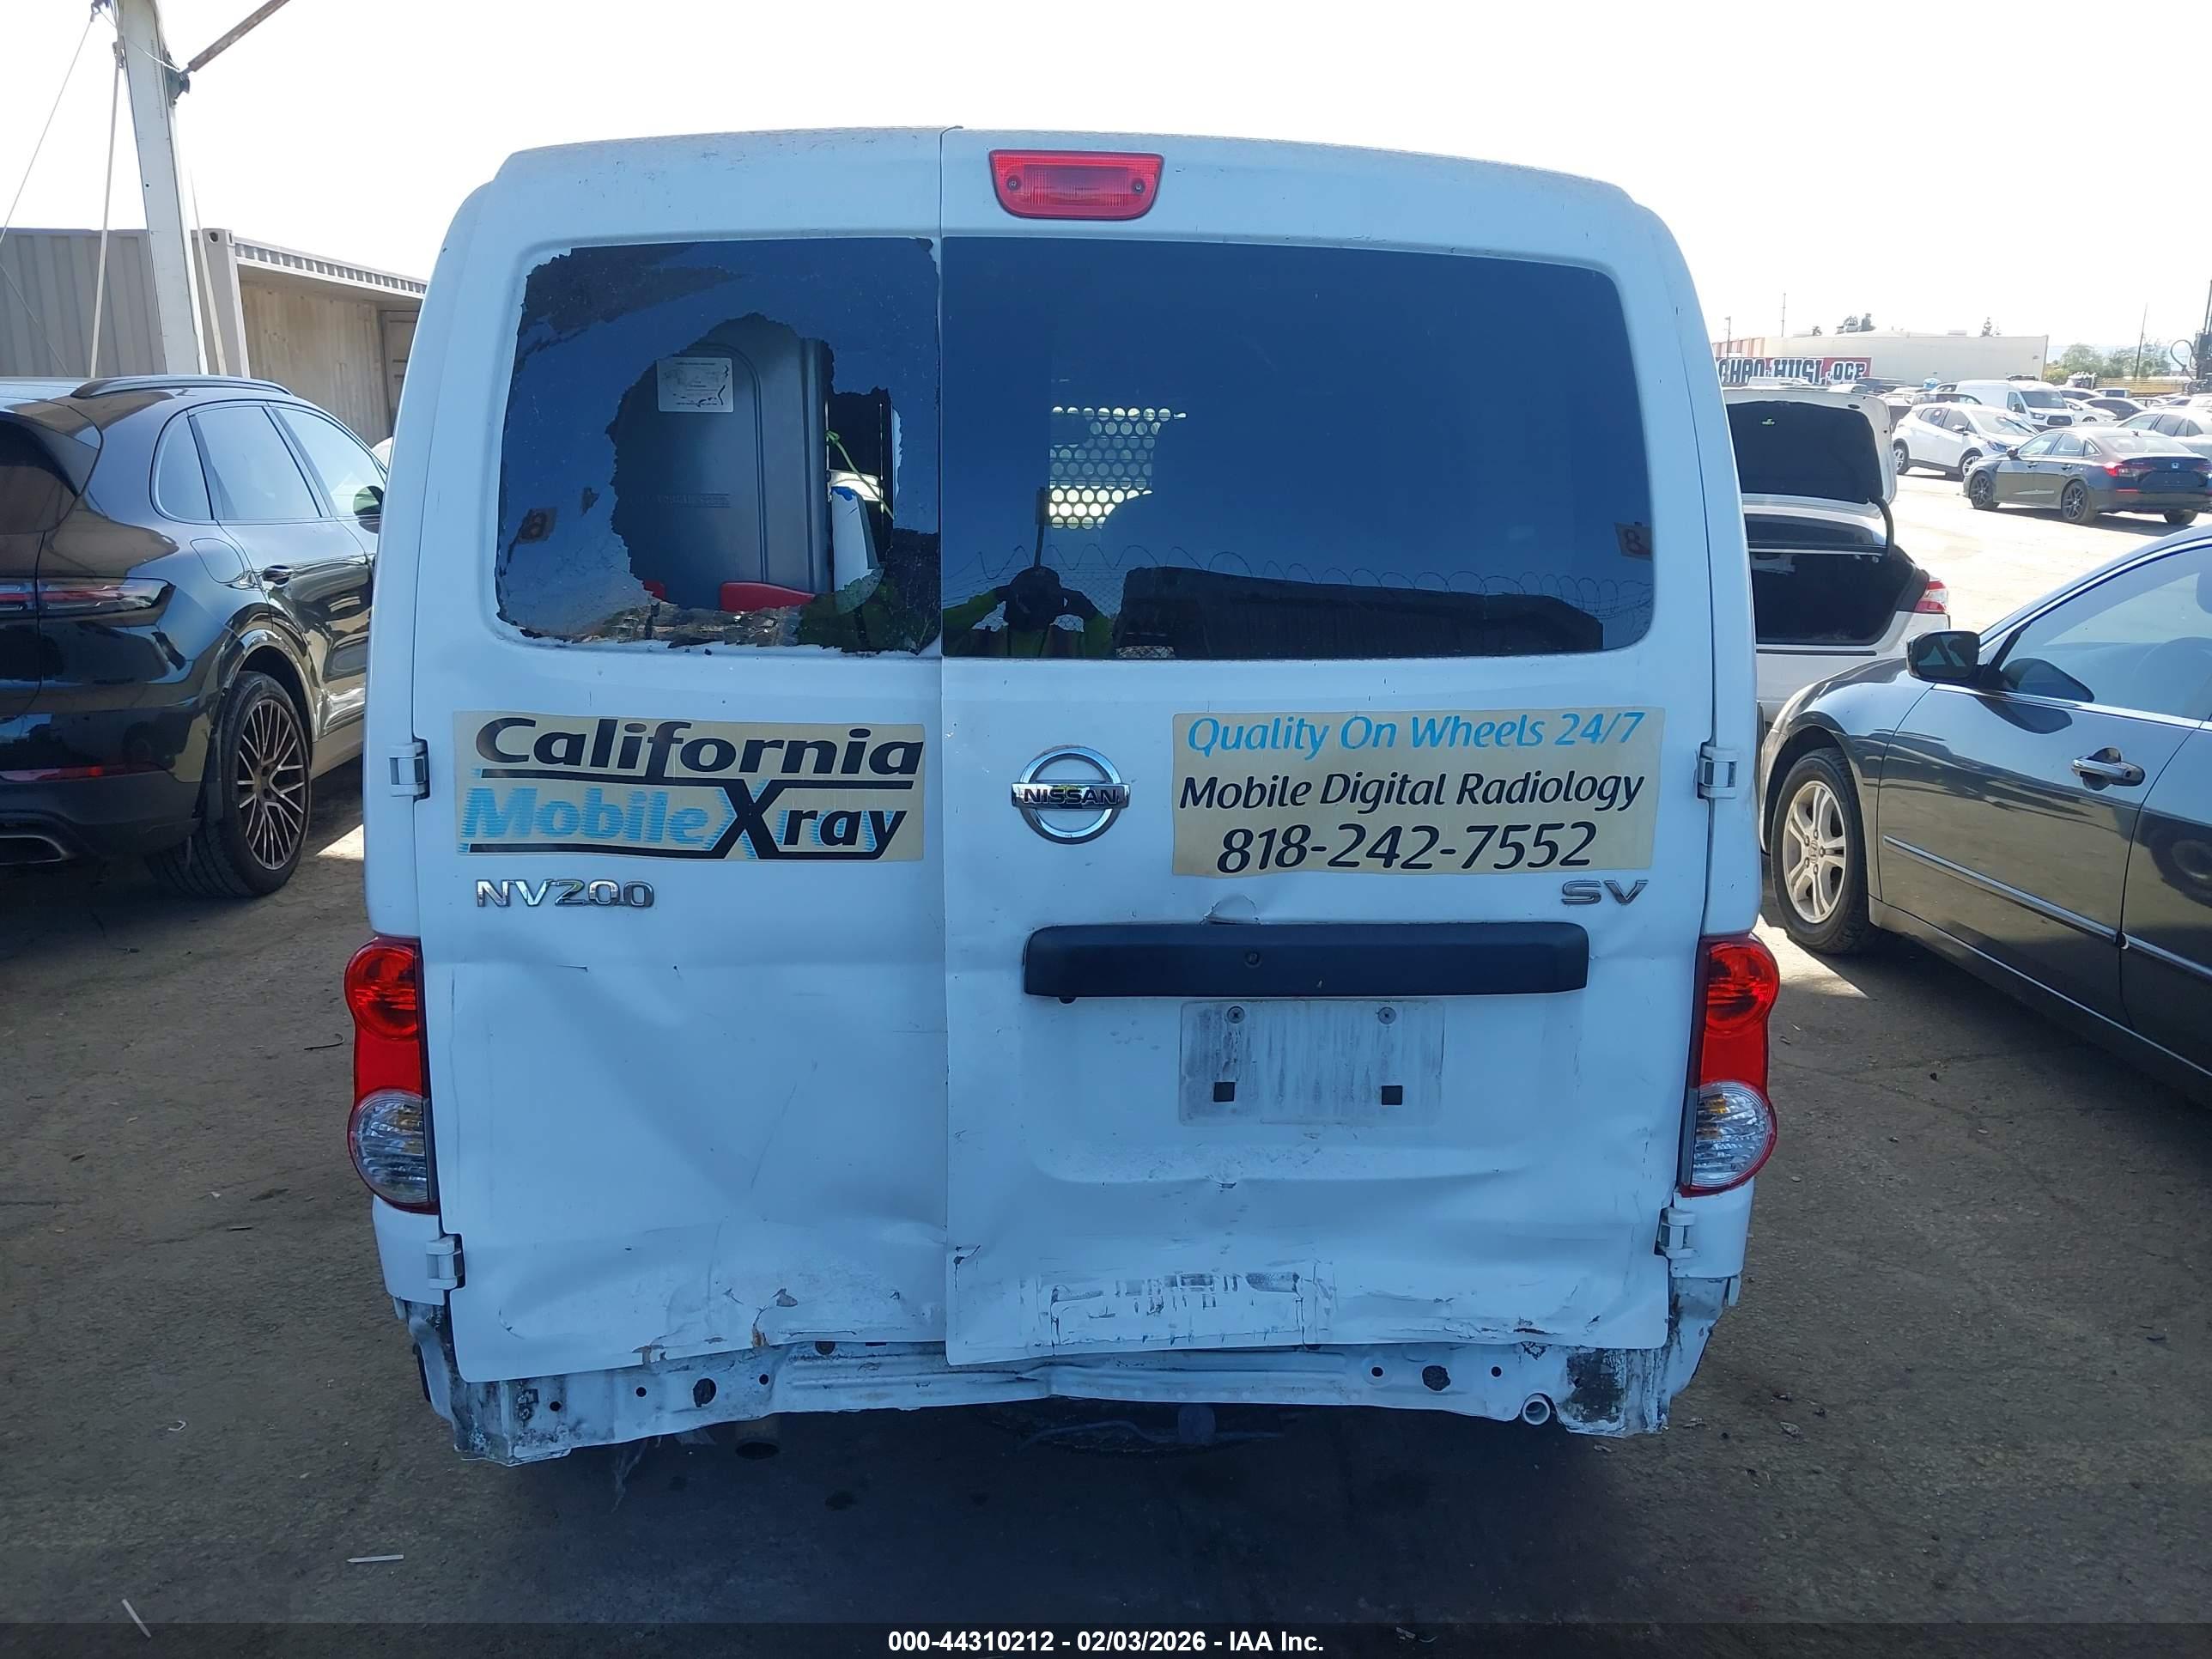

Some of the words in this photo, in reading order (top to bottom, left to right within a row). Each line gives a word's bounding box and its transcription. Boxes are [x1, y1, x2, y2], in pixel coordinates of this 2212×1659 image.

[475, 716, 924, 778] California
[1188, 716, 1330, 760] Quality
[1340, 716, 1397, 751] On
[1411, 714, 1545, 750] Wheels
[1554, 712, 1645, 745] 24/7
[1023, 788, 1116, 805] NISSAN
[1179, 774, 1312, 810] Mobile
[1320, 772, 1448, 814] Digital
[1455, 771, 1645, 811] Radiology
[460, 787, 710, 845] Mobile
[711, 779, 908, 859] Xray
[1216, 821, 1597, 874] 818-242-7552
[475, 879, 655, 908] NV200
[1560, 879, 1650, 906] SV
